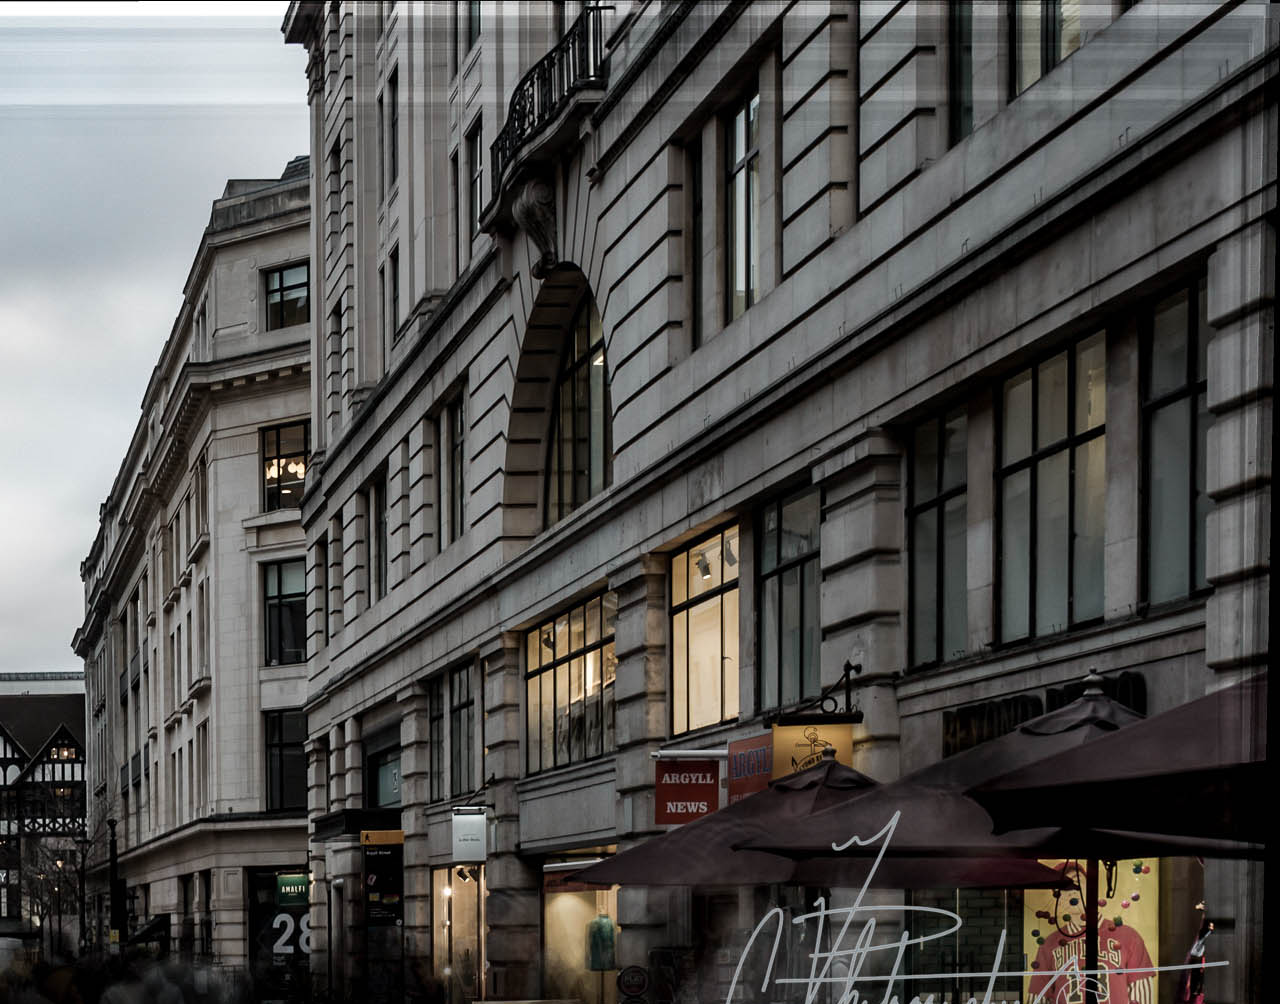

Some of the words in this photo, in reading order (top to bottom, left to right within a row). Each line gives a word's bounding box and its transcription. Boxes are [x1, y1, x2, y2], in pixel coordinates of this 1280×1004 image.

[730, 746, 773, 779] ARGYL
[661, 772, 715, 785] ARGYLL
[666, 801, 709, 814] NEWS
[281, 885, 305, 894] AMALFI
[272, 913, 312, 954] 28
